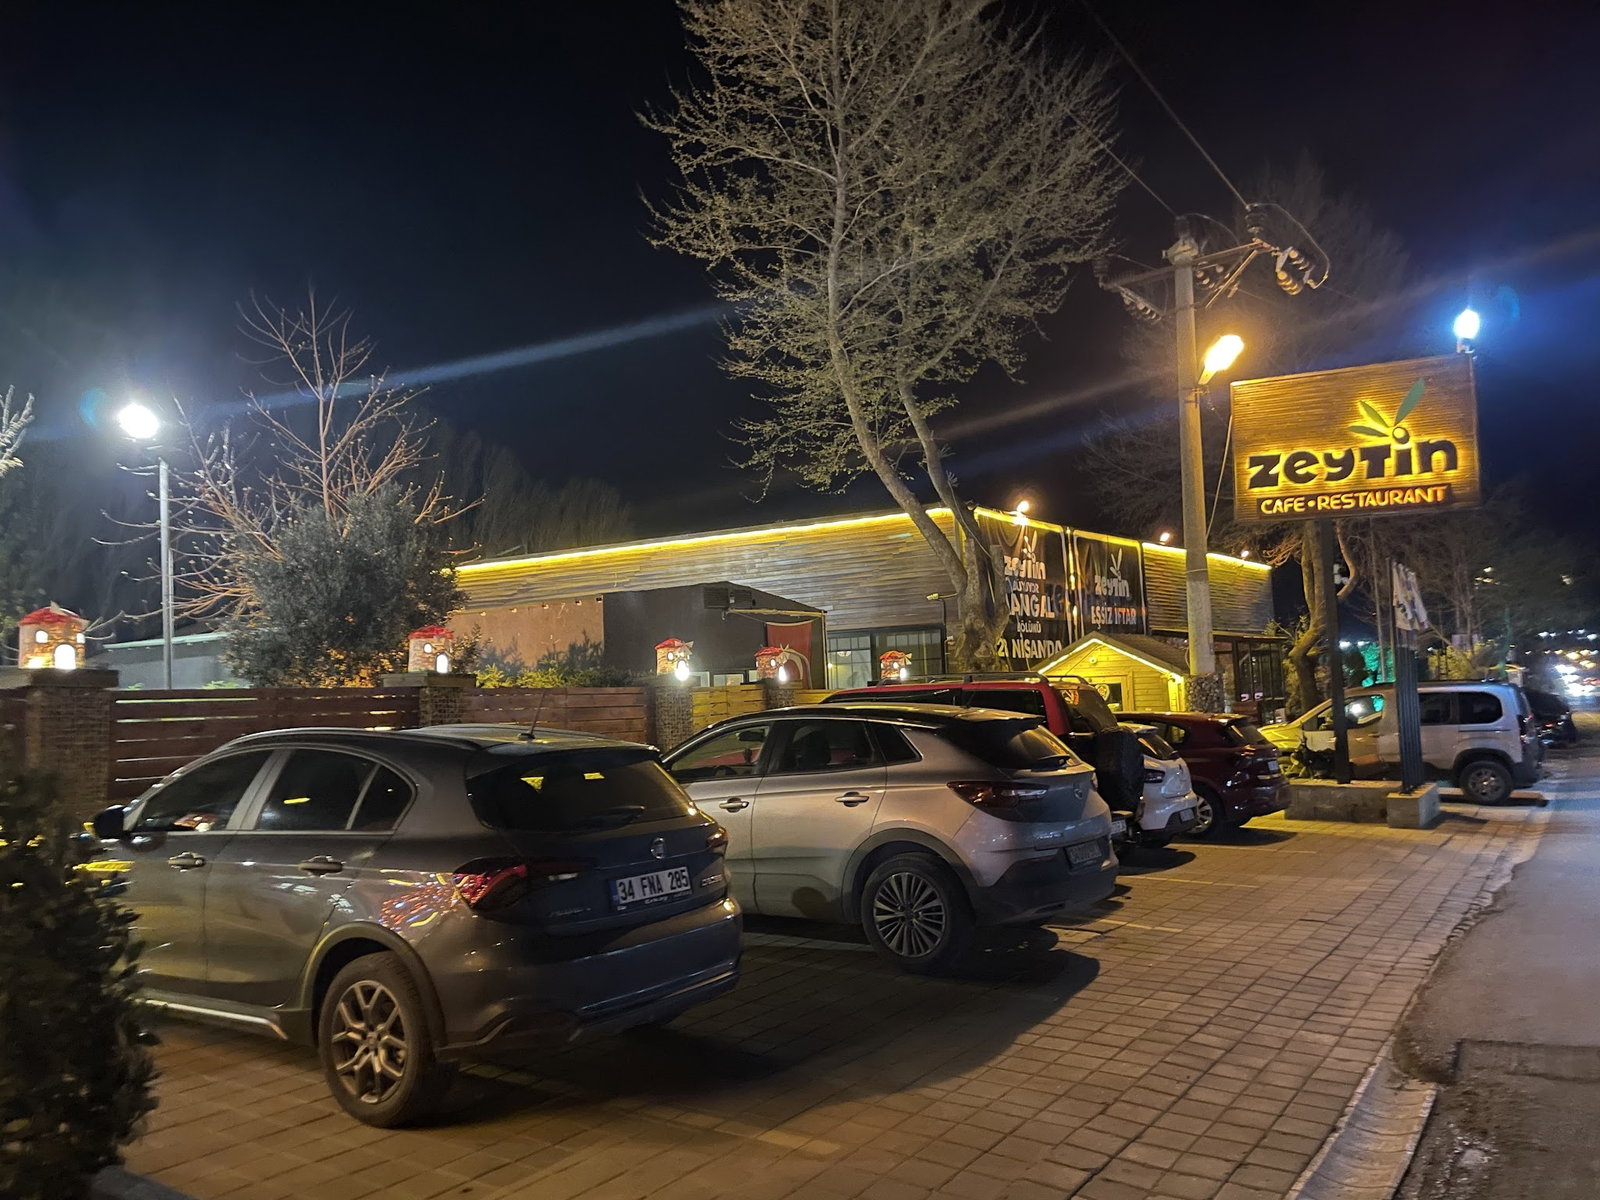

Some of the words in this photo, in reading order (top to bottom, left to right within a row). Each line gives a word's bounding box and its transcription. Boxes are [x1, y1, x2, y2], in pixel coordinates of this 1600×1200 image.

[1316, 485, 1448, 510] RESTAURANT
[1008, 593, 1056, 619] ANGAL
[618, 881, 634, 901] 34
[641, 874, 664, 896] FNA
[668, 869, 689, 891] 285
